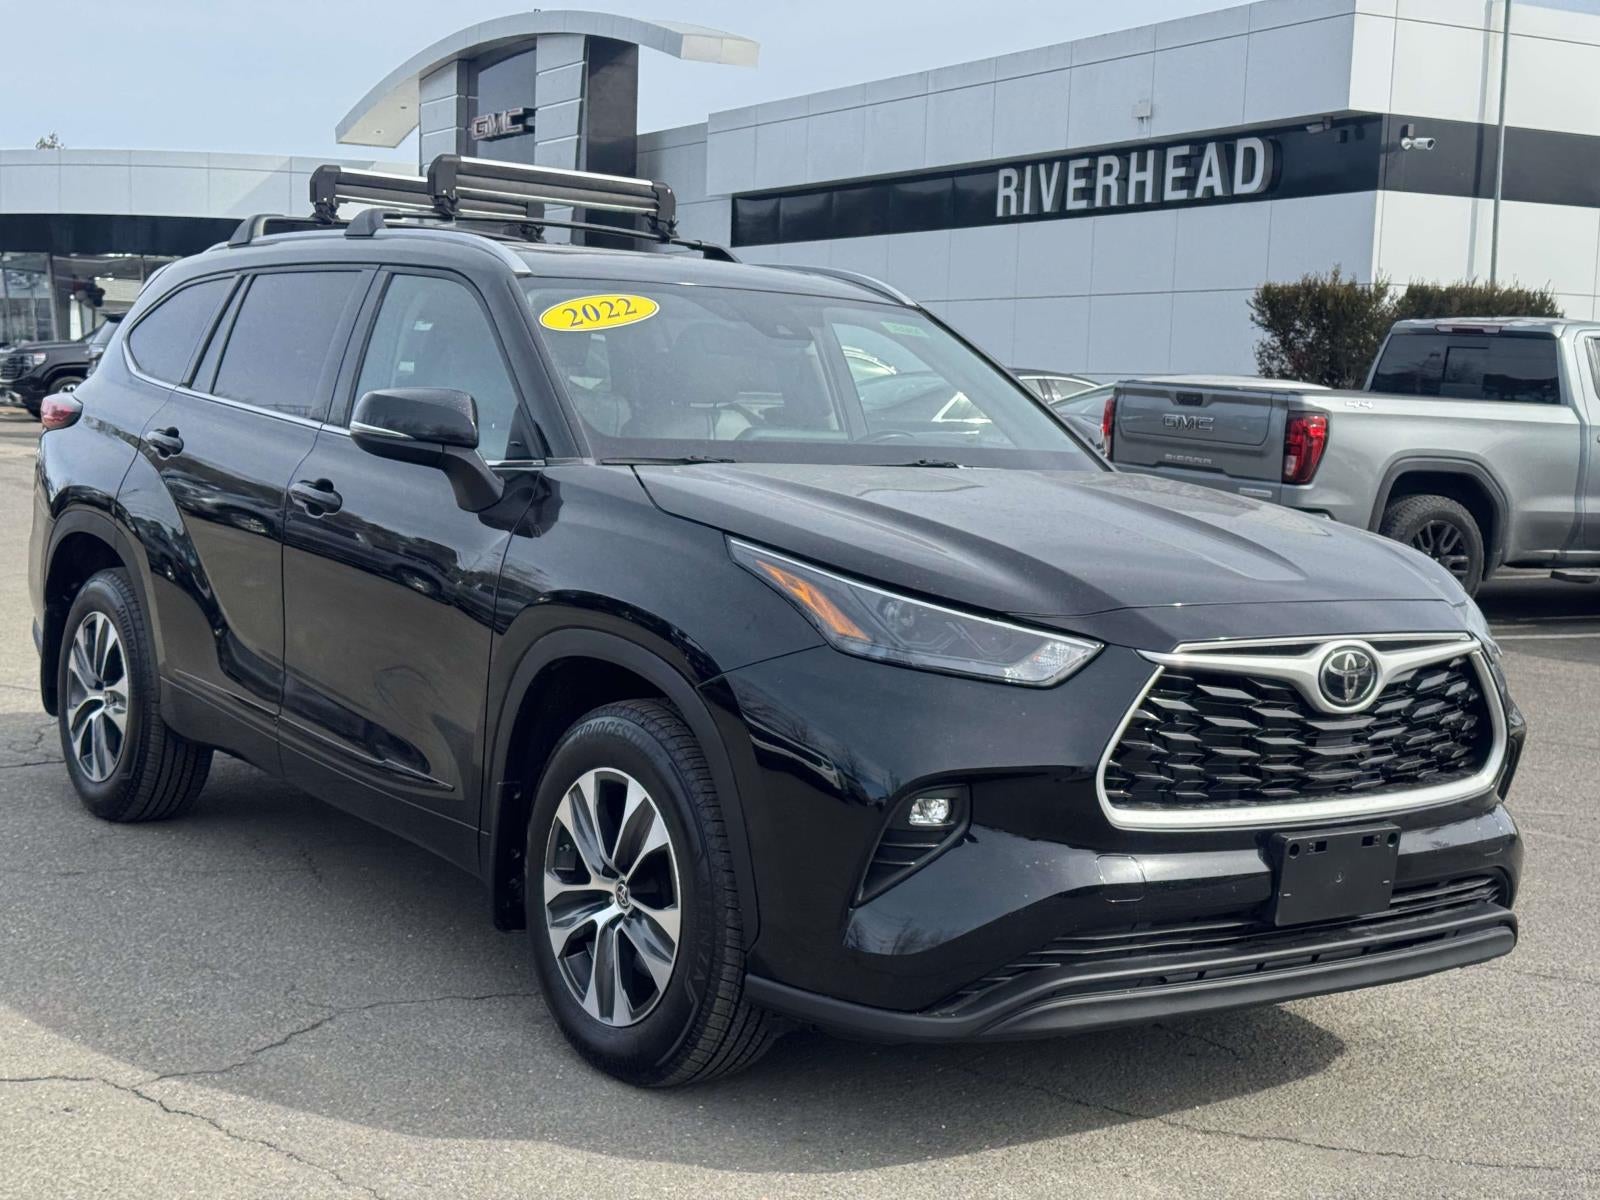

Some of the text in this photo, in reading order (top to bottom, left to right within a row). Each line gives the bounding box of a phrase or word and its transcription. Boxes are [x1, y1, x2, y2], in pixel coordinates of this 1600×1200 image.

[472, 107, 524, 140] GMC
[996, 136, 1272, 217] RIVERHEAD
[562, 298, 637, 327] 2022
[1162, 413, 1215, 431] GMC
